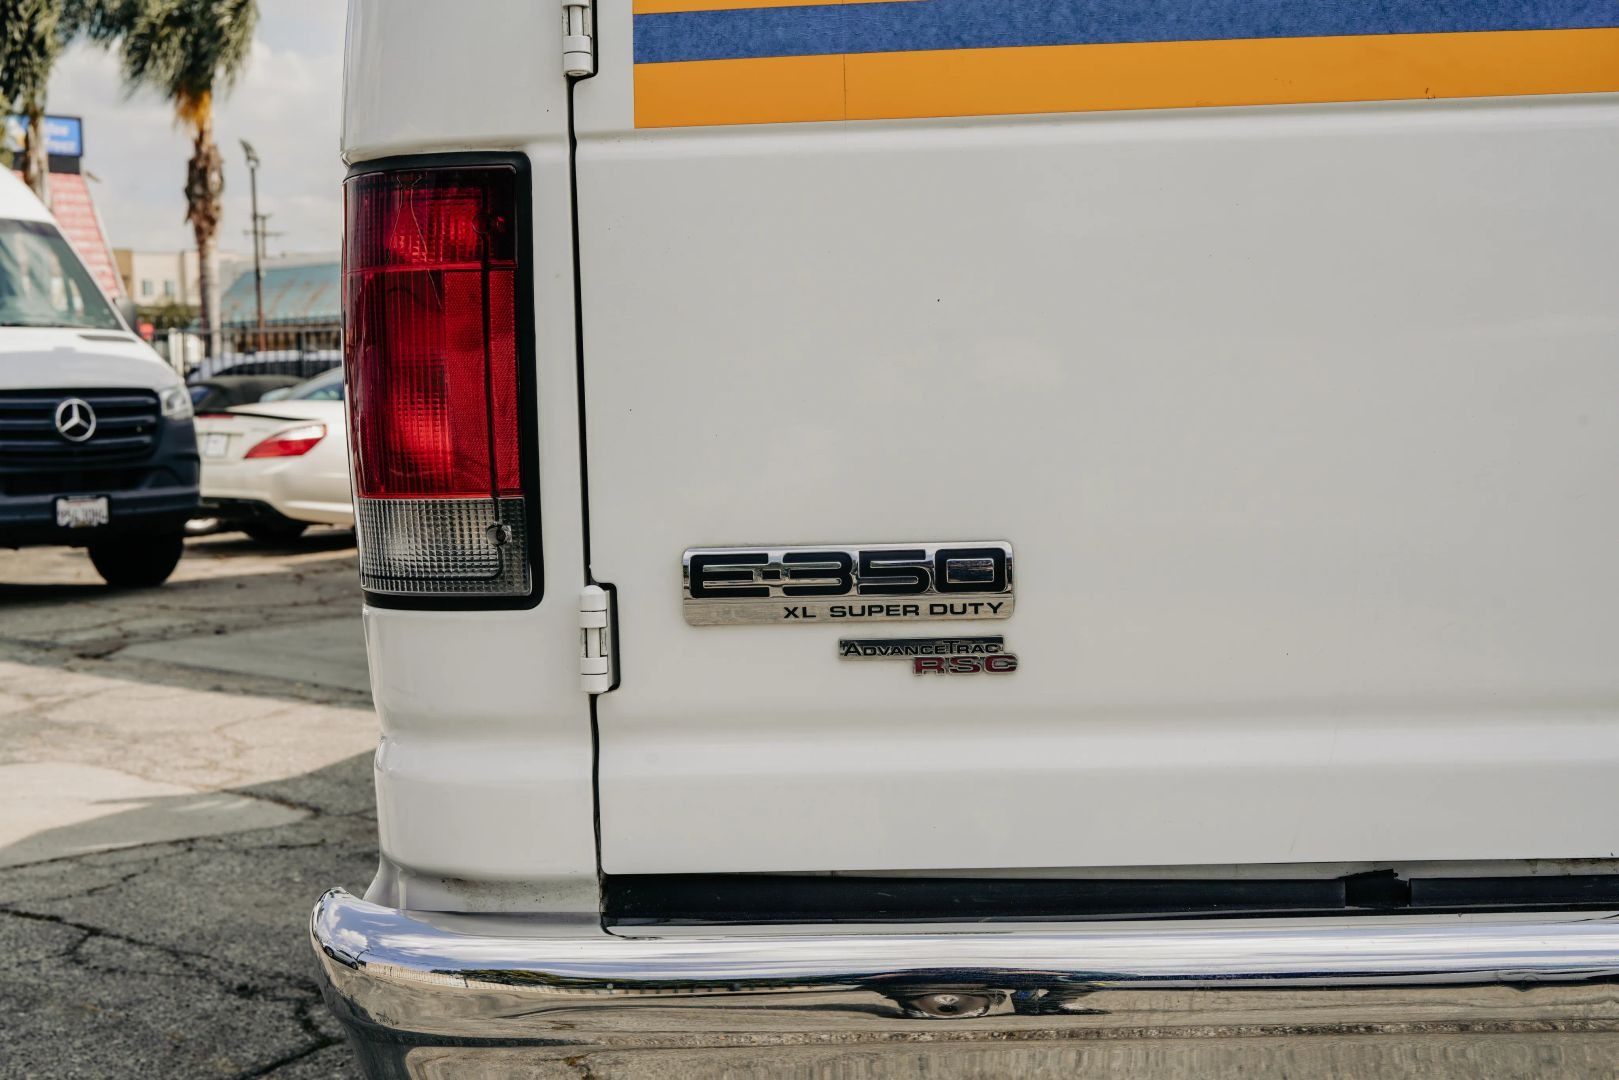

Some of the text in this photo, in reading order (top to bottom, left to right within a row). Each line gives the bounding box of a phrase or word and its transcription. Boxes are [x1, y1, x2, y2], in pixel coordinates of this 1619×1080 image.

[690, 547, 1008, 599] E-350
[783, 601, 1004, 619] XL SUPER DUTY
[912, 654, 1018, 675] RSC
